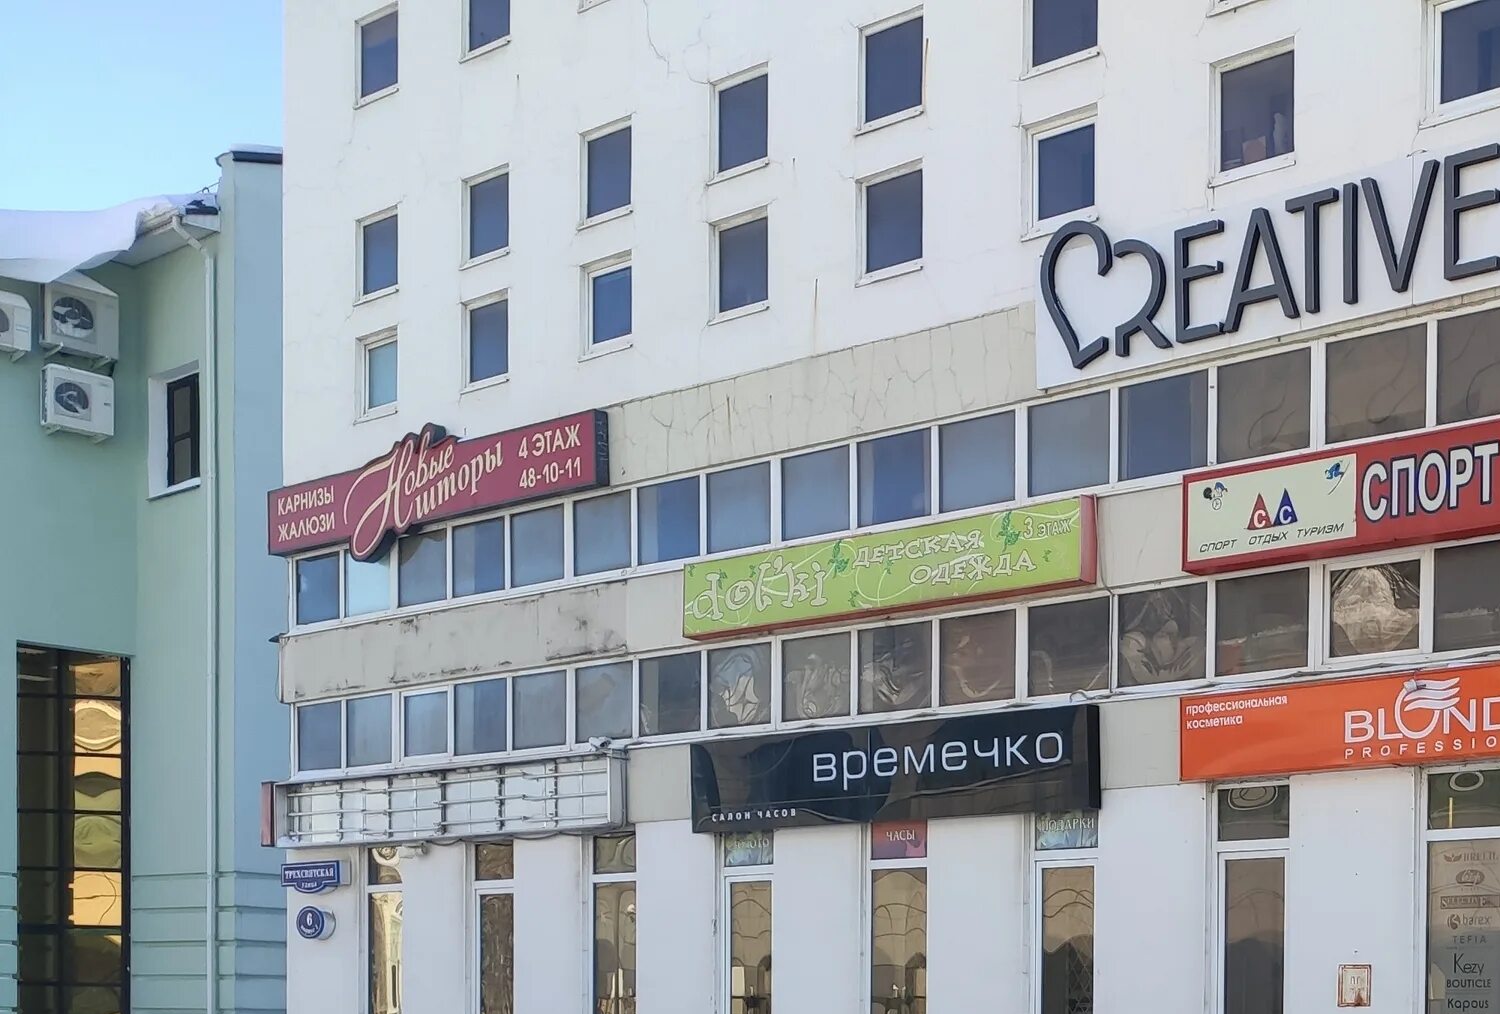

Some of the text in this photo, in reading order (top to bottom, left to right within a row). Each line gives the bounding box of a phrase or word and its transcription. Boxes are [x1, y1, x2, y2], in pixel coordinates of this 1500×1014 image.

[518, 423, 582, 460] 4 ЭТАЖ
[414, 441, 504, 520] шторы
[519, 457, 582, 490] 48-10-11
[1361, 441, 1500, 522] СПОРТ
[277, 485, 335, 517] КАРНИЗЫ
[344, 430, 455, 556] Новые
[277, 511, 336, 542] ЖАЛЮЗИ
[1023, 516, 1072, 538] 3 ЭТАЖ
[1199, 522, 1345, 553] СПОРТ ОТДЫХ ТУРИЗМ
[851, 529, 983, 568] ДЕТСКАЯ
[909, 549, 1037, 586] ОДЕЖДА
[1185, 694, 1288, 716] профессиональная
[1185, 713, 1244, 731] косметика
[812, 731, 1063, 791] времечко
[711, 808, 796, 822] САЛОН ЧАСОВ
[886, 829, 915, 841] ЧАСЫ
[306, 912, 313, 926] 6
[1462, 914, 1490, 926] barex
[1452, 935, 1487, 944] TEFIA
[1453, 953, 1485, 975] Kezy
[1447, 998, 1490, 1012] Kapous
